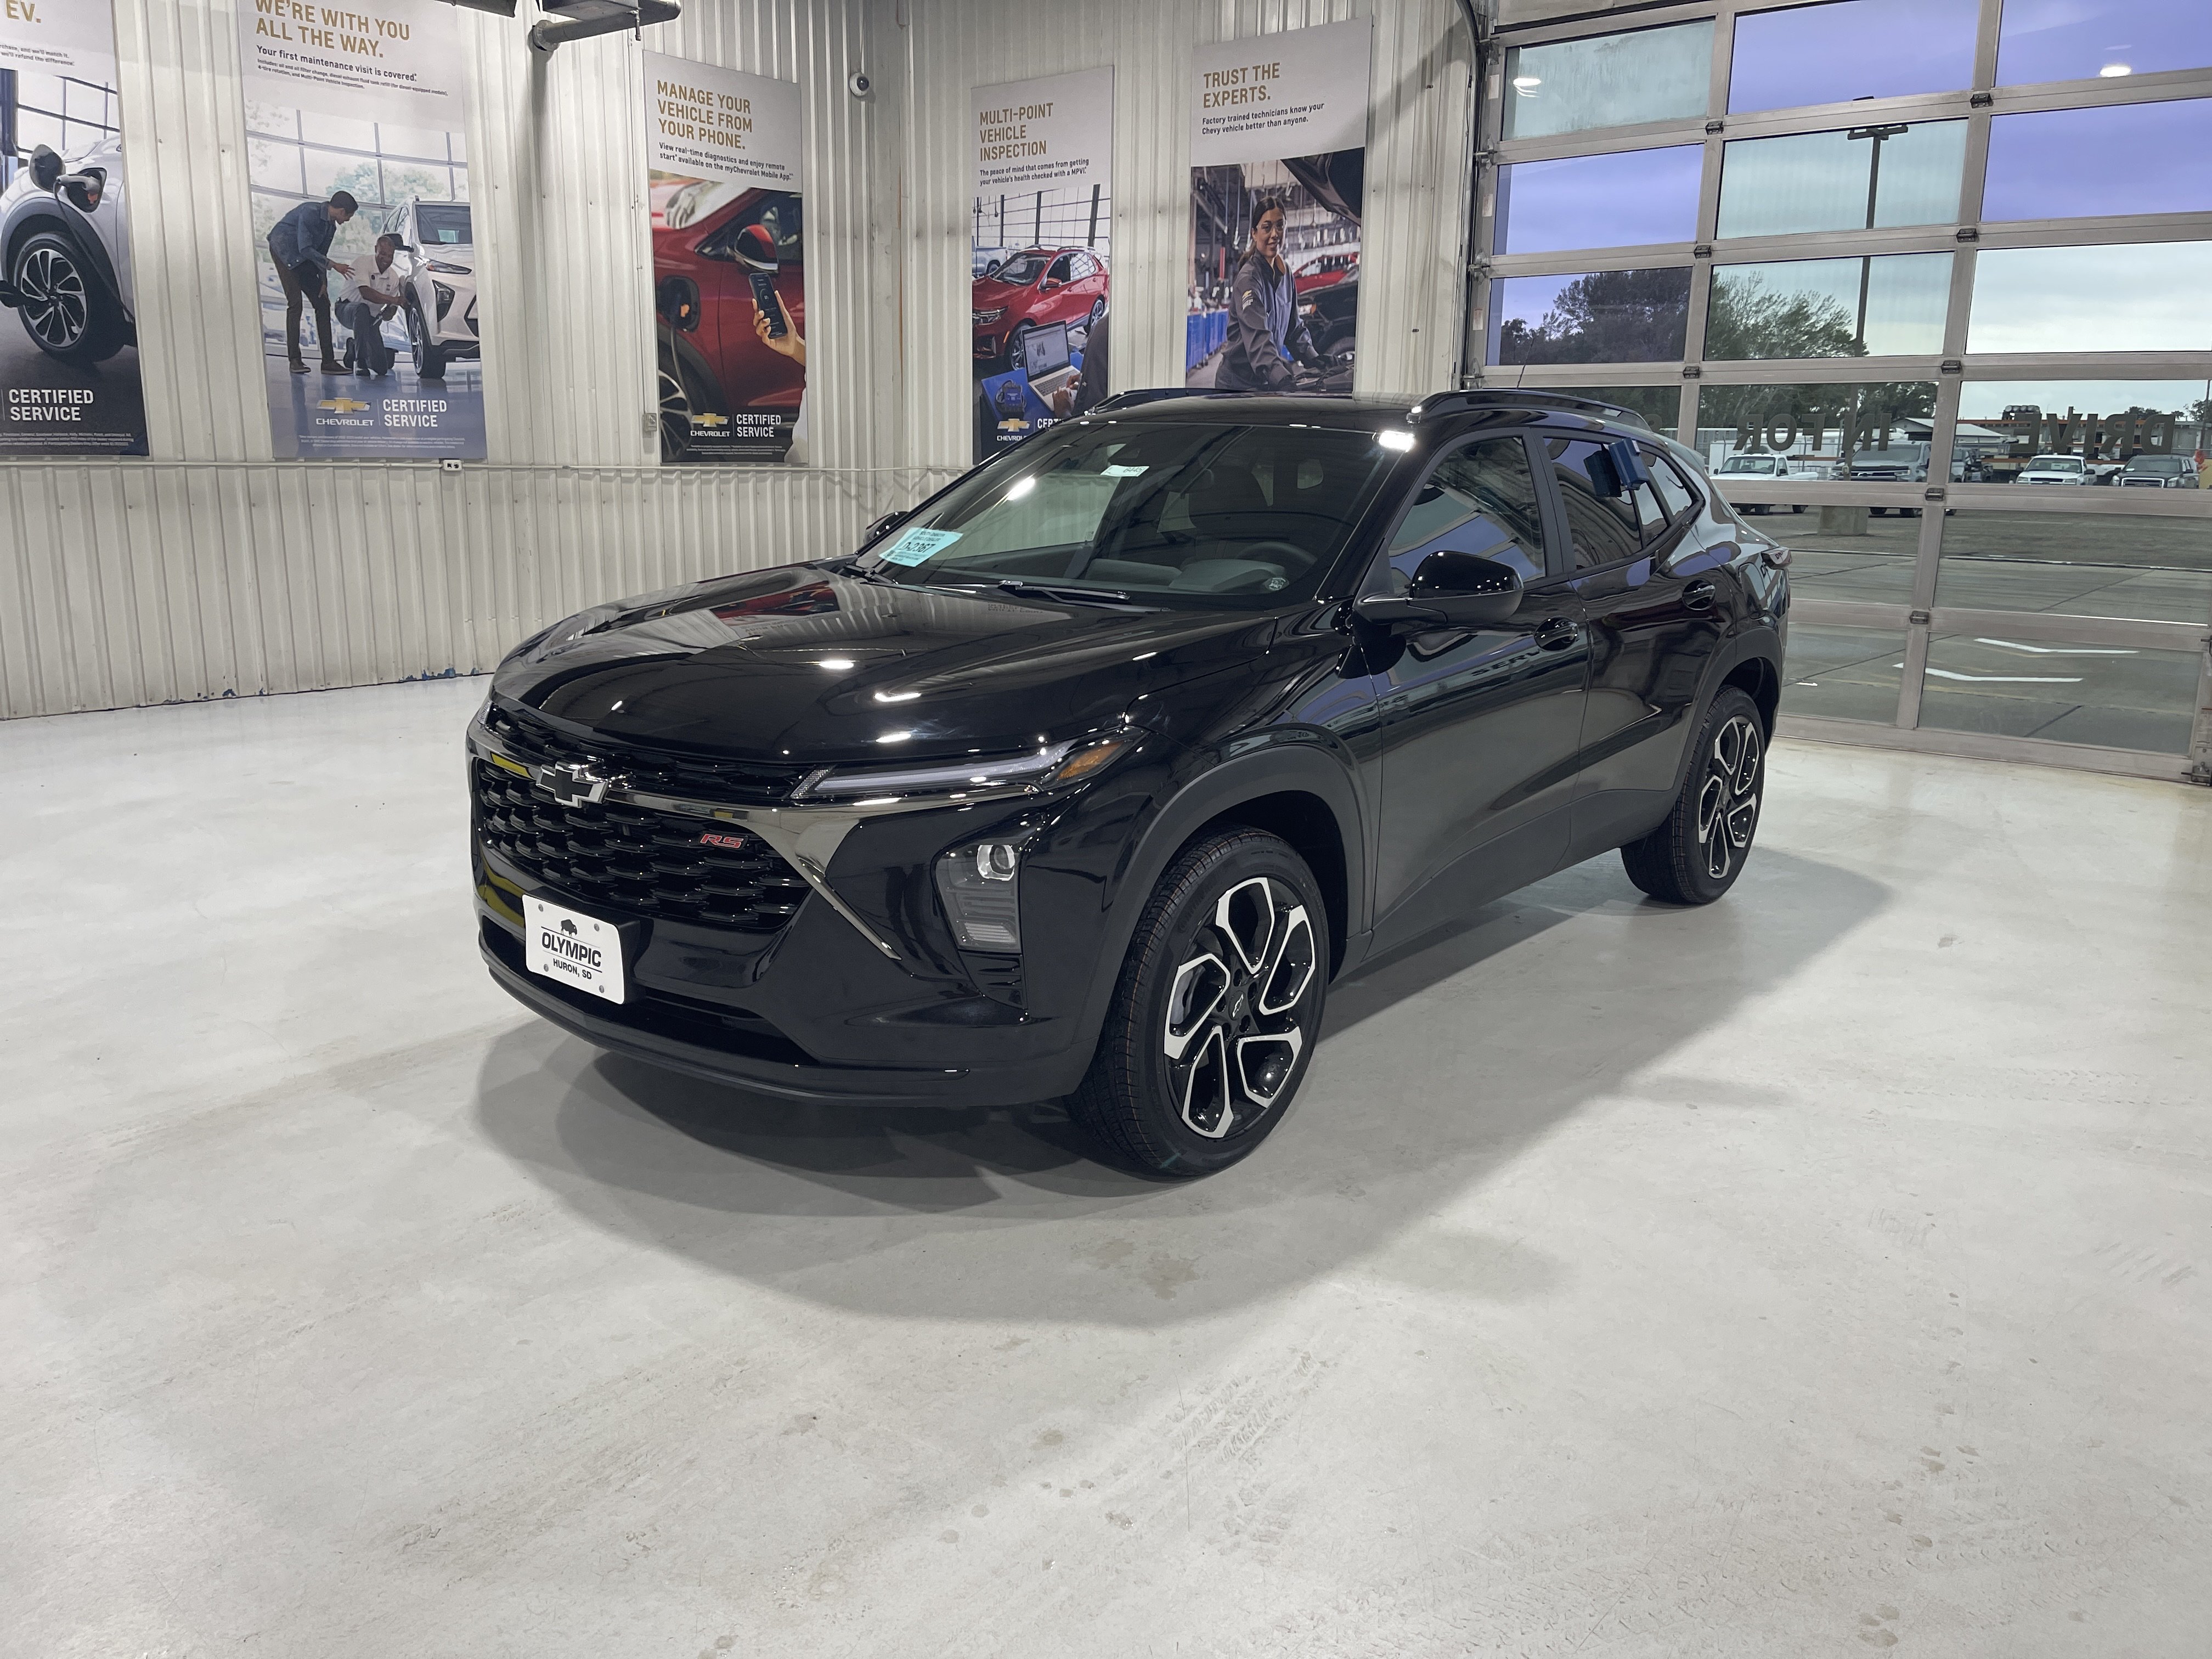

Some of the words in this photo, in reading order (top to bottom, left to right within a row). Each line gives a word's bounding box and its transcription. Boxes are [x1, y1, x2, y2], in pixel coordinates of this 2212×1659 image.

[6, 0, 42, 23] EV.
[256, 0, 316, 23] WE'RE
[321, 8, 369, 33] WITH
[375, 18, 410, 41] YOU
[256, 18, 293, 41] ALL
[298, 25, 335, 49] THE
[340, 33, 383, 58] WAY.
[256, 44, 277, 57] Your
[279, 49, 298, 61] first
[300, 55, 353, 71] maintenance
[355, 64, 373, 75] visit
[374, 67, 381, 76] is
[1203, 67, 1248, 89] TRUST
[1252, 62, 1280, 82] THE
[657, 80, 714, 107] MANAGE
[717, 93, 751, 114] YOUR
[1203, 85, 1271, 109] EXPERTS.
[657, 99, 714, 125] VEHICLE
[718, 112, 752, 133] FROM
[980, 102, 1053, 126] MULTI-POINT
[1202, 116, 1226, 125] Factory
[1227, 111, 1250, 122] trained
[1251, 108, 1288, 120] technicians
[1289, 105, 1307, 114] know
[1308, 103, 1325, 112] your
[658, 118, 695, 140] YOUR
[698, 126, 746, 150] PHONE.
[980, 124, 1026, 144] VEHICLE
[1202, 126, 1221, 135] Chevy
[1222, 123, 1244, 133] vehicle
[1245, 121, 1265, 131] better
[1267, 119, 1282, 127] than
[1283, 116, 1309, 127] anyone.
[659, 142, 674, 151] View
[675, 146, 703, 157] real-time
[704, 151, 737, 164] diagnostics
[749, 160, 764, 170] enjoy
[765, 162, 785, 171] remote
[980, 140, 1047, 161] INSPECTION
[678, 156, 704, 167] available
[714, 162, 724, 171] the
[724, 166, 760, 177] myChevrolet
[761, 170, 778, 179] Mobile
[980, 178, 991, 187] your
[992, 175, 1013, 184] vehicle's
[1014, 173, 1030, 182] health
[1031, 171, 1053, 180] checked
[1054, 169, 1065, 177] with
[990, 167, 1005, 177] peace
[1012, 165, 1024, 173] mind
[1069, 159, 1089, 167] getting
[9, 388, 94, 404] CERTIFIED
[383, 398, 447, 413] CERTIFIED
[10, 406, 81, 421] SERVICE
[315, 417, 374, 427] CHEVROLET
[384, 414, 438, 427] SERVICE
[736, 414, 781, 425] CERTIFIED
[737, 426, 775, 437] SERVICE
[700, 833, 744, 849] RS
[541, 932, 602, 967] OLYMPIC
[553, 958, 580, 978] HURON,
[582, 969, 592, 980] SD
